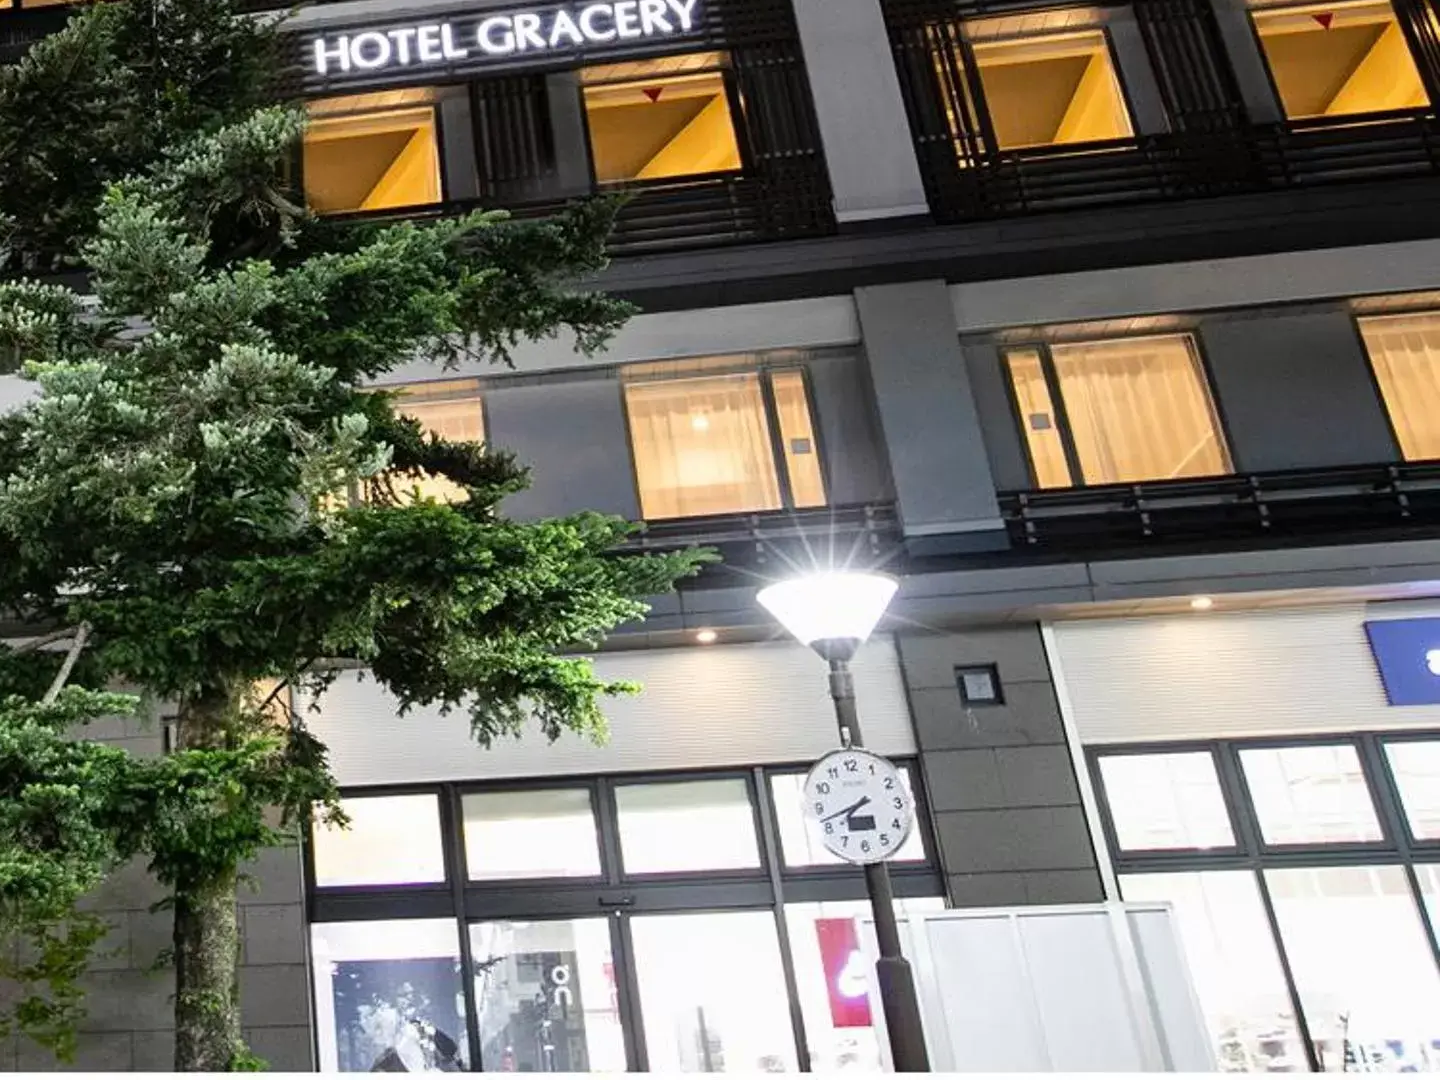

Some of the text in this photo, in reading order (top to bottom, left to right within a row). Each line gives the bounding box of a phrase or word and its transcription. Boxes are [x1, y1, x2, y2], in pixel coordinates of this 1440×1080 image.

[314, 24, 467, 74] HOTEL
[844, 759, 858, 772] 12
[869, 764, 875, 775] 1
[828, 767, 838, 780] 11
[816, 782, 830, 795] 10
[884, 777, 894, 790] 2
[815, 802, 824, 815] 9
[893, 797, 903, 810] 3
[824, 822, 833, 834] 8
[892, 818, 901, 830] 4
[840, 835, 849, 848] 7
[861, 840, 871, 853] 6
[880, 834, 889, 846] 5
